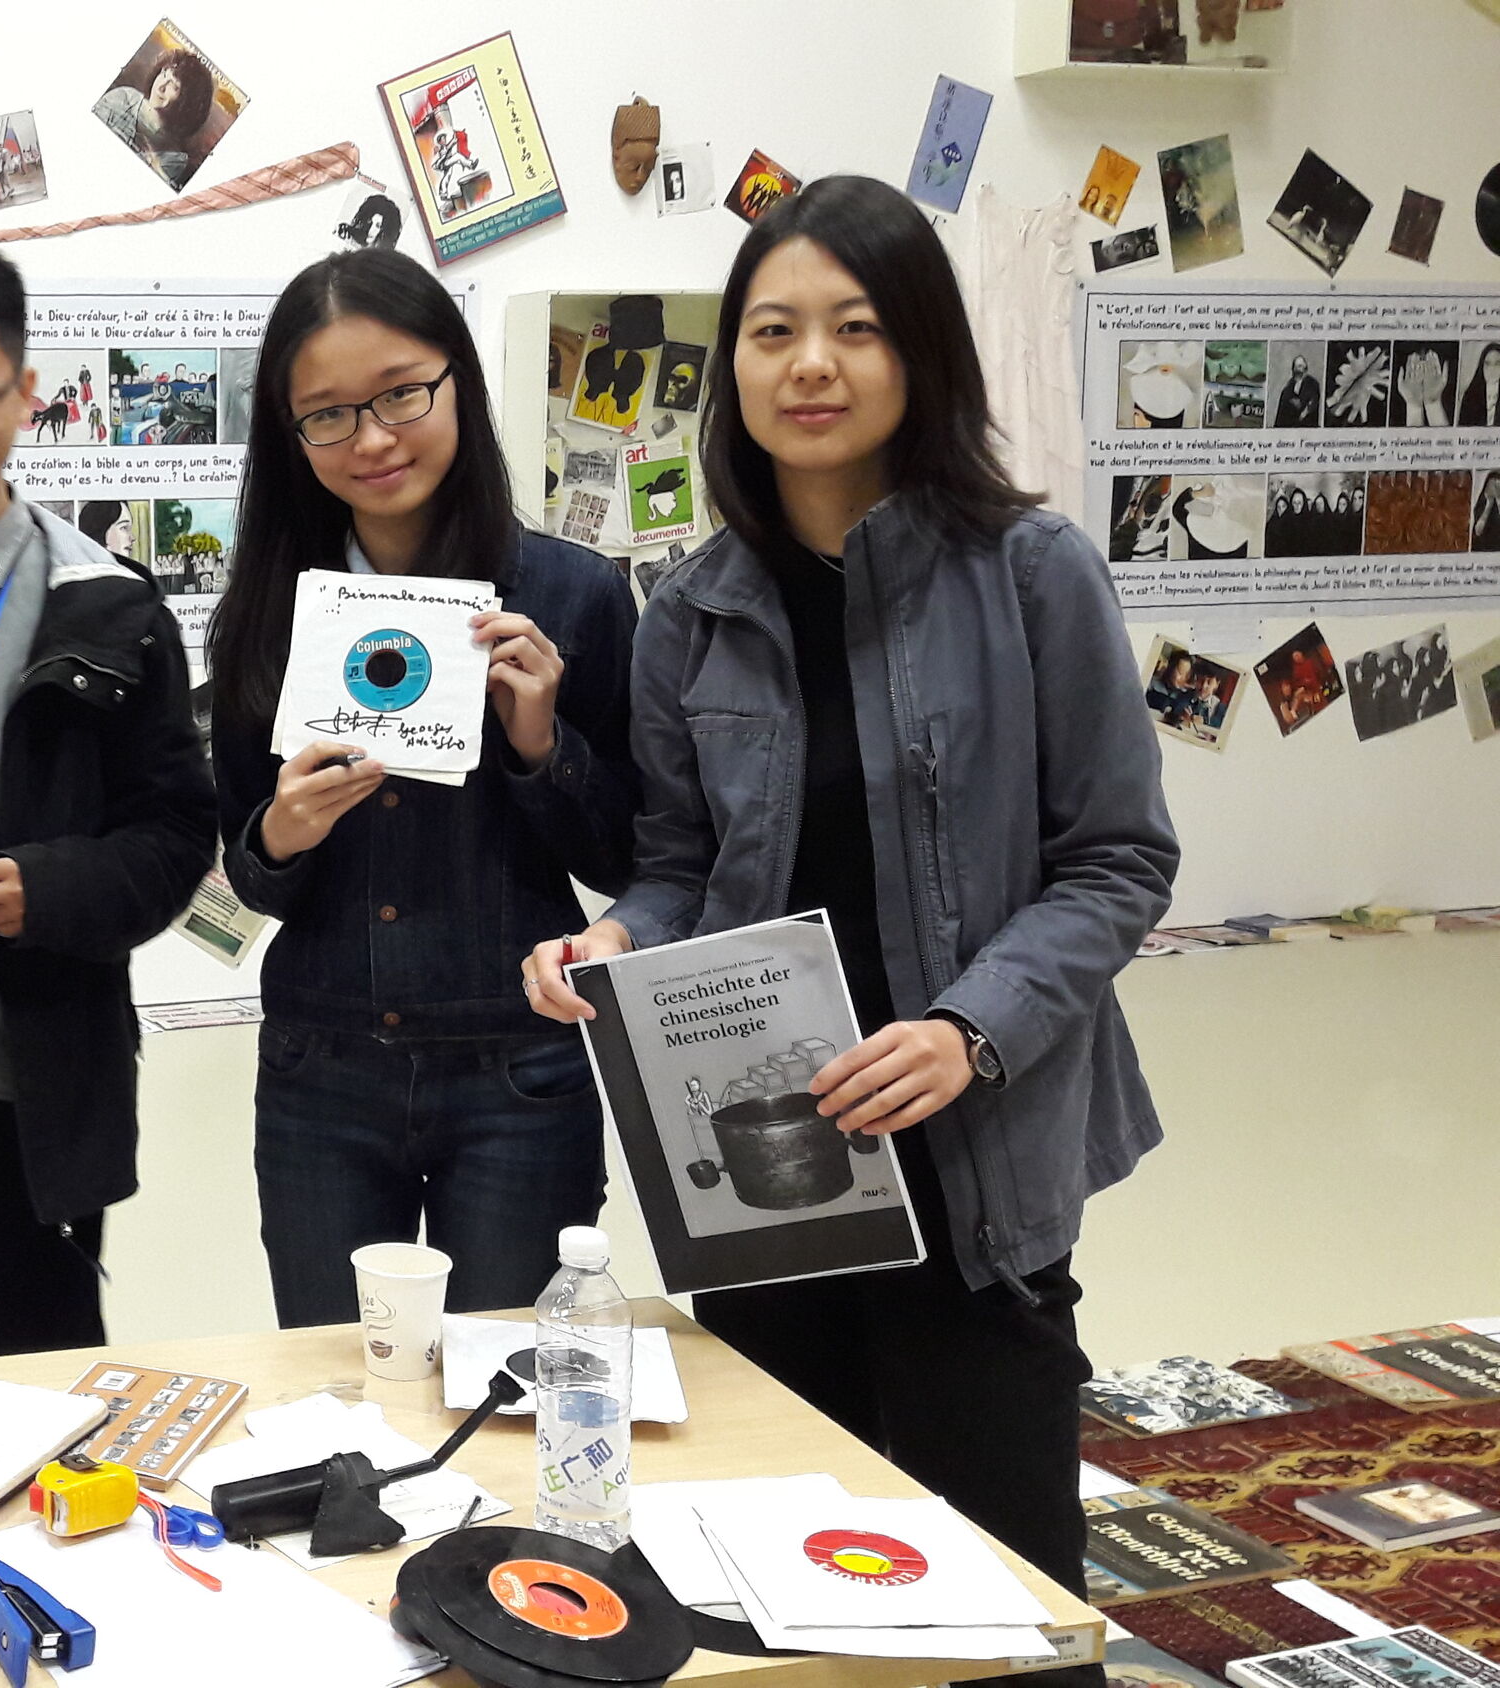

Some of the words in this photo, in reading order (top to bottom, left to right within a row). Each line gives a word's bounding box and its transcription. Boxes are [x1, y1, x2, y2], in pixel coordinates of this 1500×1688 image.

[33, 309, 43, 322] le
[155, 310, 178, 322] créé
[224, 310, 234, 321] le
[238, 309, 266, 322] Dieu-
[25, 329, 59, 341] permis
[73, 326, 85, 338] lui
[91, 326, 101, 338] le
[105, 325, 176, 338] Dieu-créateur
[193, 325, 217, 338] faire
[223, 325, 233, 337] la
[592, 322, 610, 338] ar
[1099, 319, 1108, 331] le
[1114, 438, 1160, 451] révolution
[1162, 438, 1173, 450] et
[1176, 438, 1184, 450] le
[625, 443, 650, 464] art
[17, 457, 27, 470] la
[82, 456, 92, 469] la
[97, 456, 121, 469] bible
[126, 459, 133, 469] a
[136, 459, 150, 469] un
[155, 459, 187, 472] corps,
[190, 457, 208, 468] une
[1090, 457, 1106, 468] vue
[26, 474, 54, 489] être,
[121, 472, 161, 484] devenu
[184, 470, 196, 482] La
[200, 470, 238, 483] création
[633, 528, 688, 544] documenta
[687, 522, 695, 535] 9
[356, 636, 413, 654] Columbia
[654, 978, 756, 1007] Geschichte
[759, 967, 790, 986] der
[660, 994, 781, 1027] chinesischen
[665, 1017, 768, 1048] Metrologie
